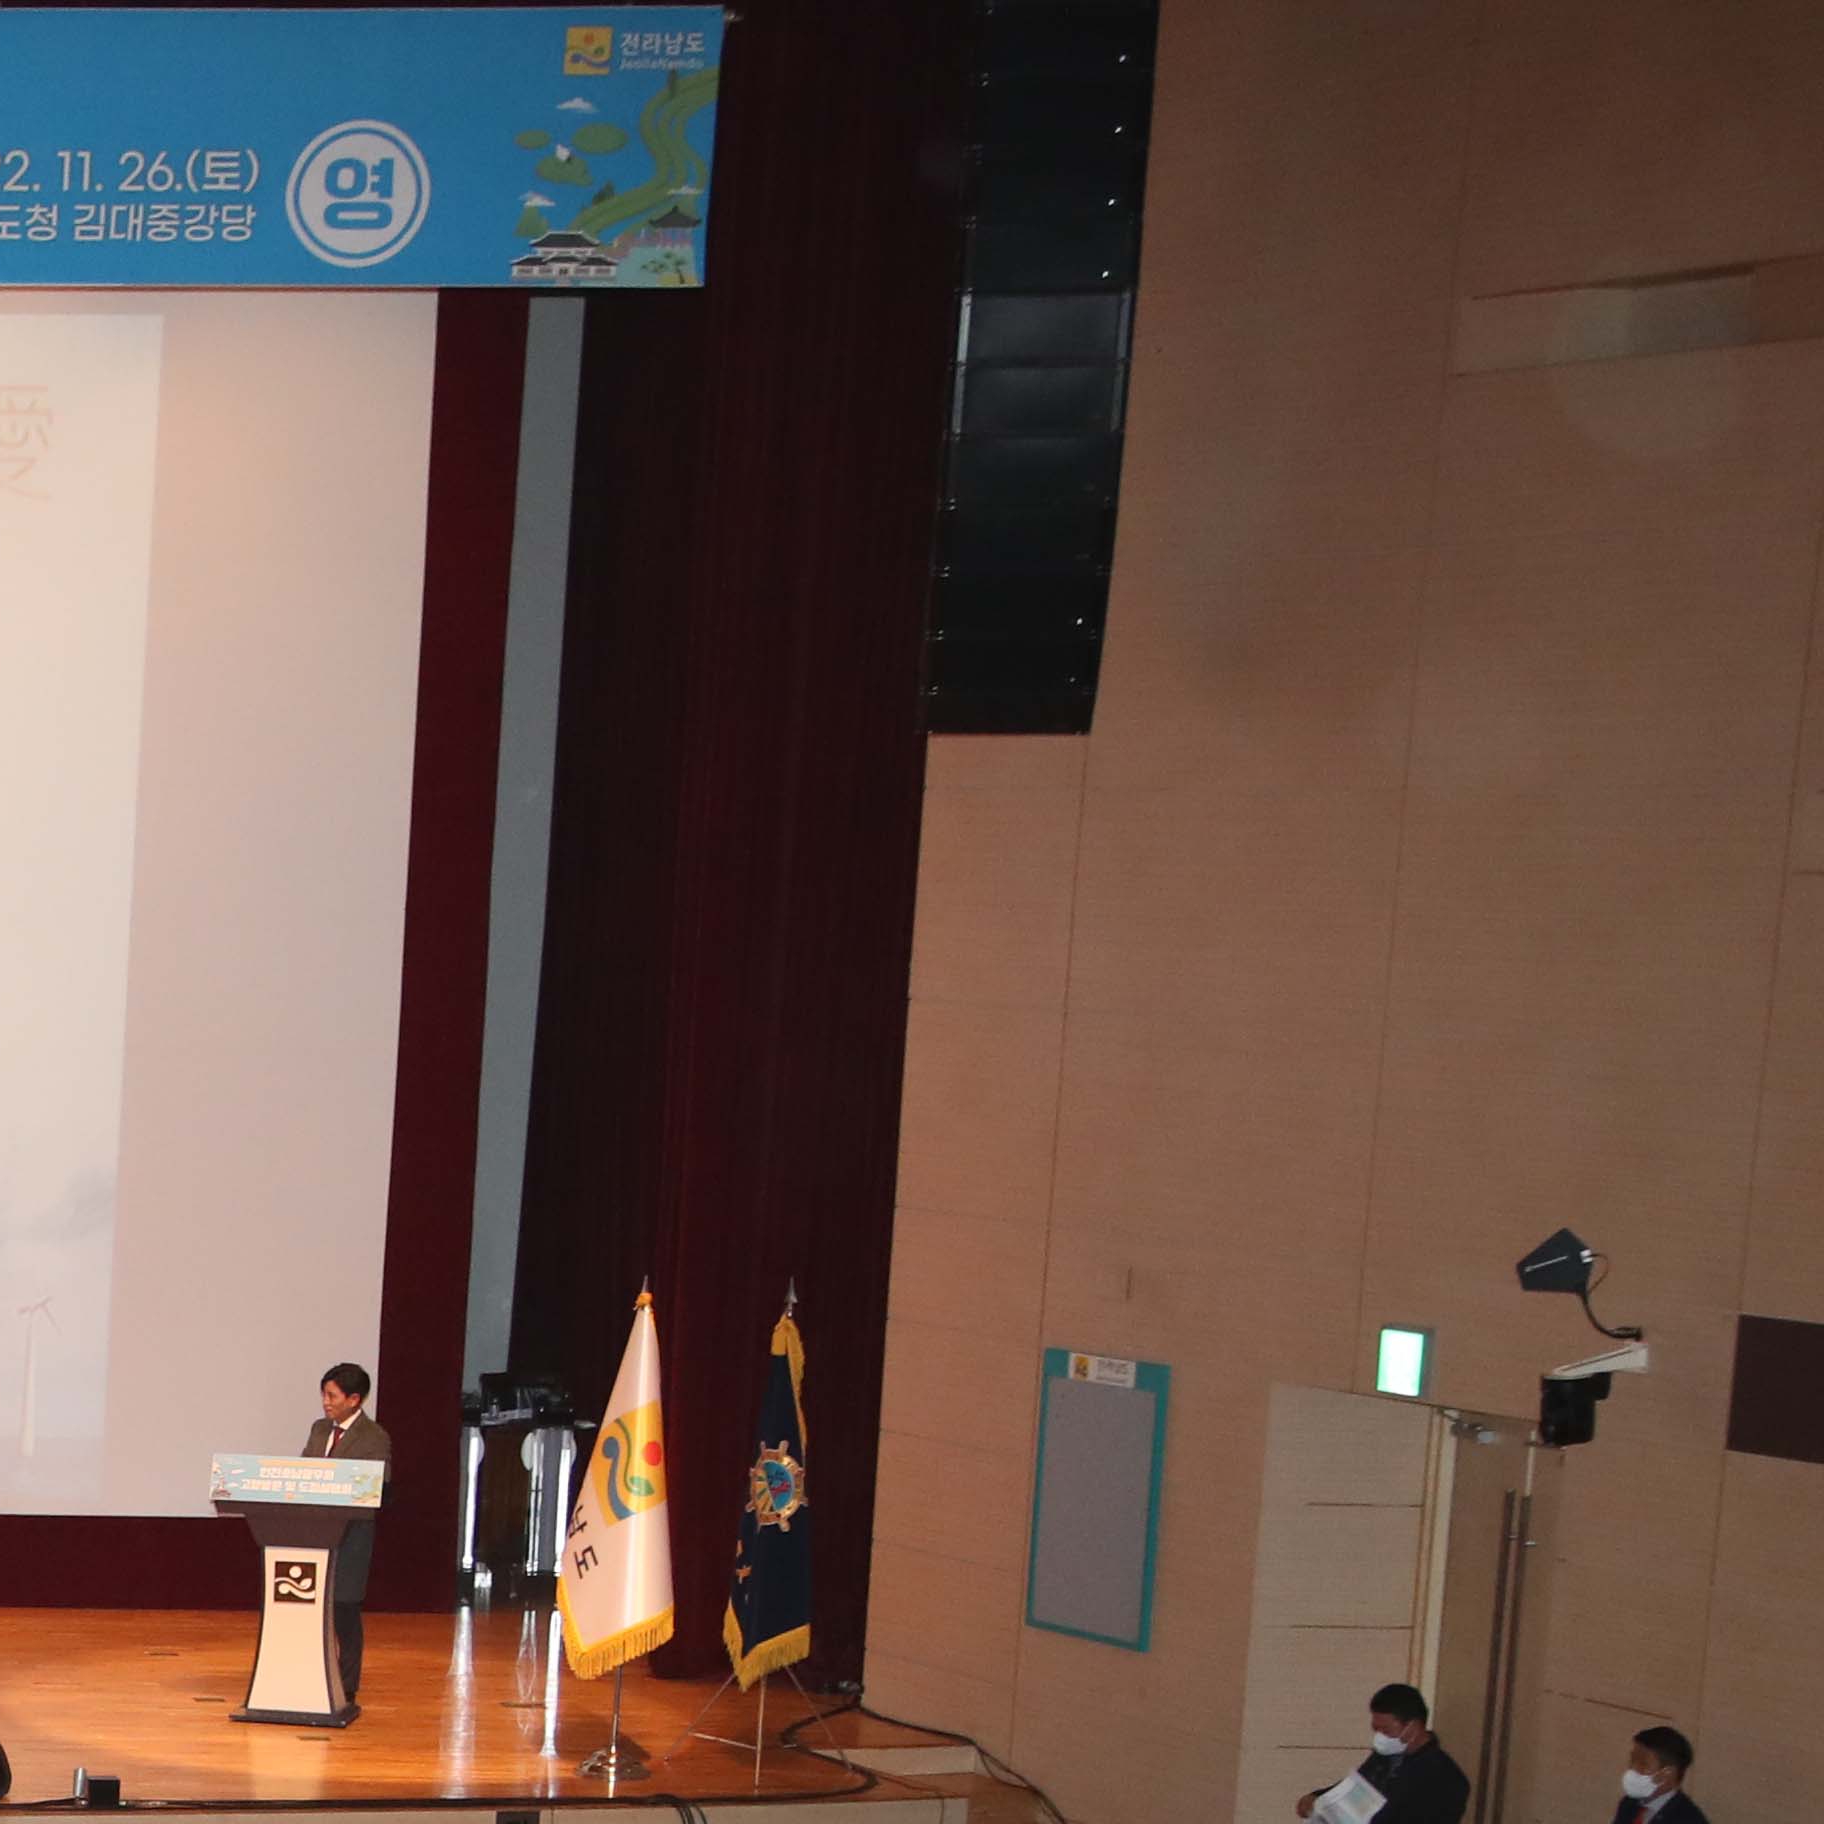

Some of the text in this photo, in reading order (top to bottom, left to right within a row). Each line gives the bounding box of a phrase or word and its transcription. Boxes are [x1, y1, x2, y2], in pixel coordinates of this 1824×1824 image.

[621, 31, 706, 56] 전라남도
[56, 151, 105, 193] 11.
[117, 149, 260, 195] 26.(토)
[322, 156, 395, 231] 영
[73, 204, 257, 243] 김대중강당
